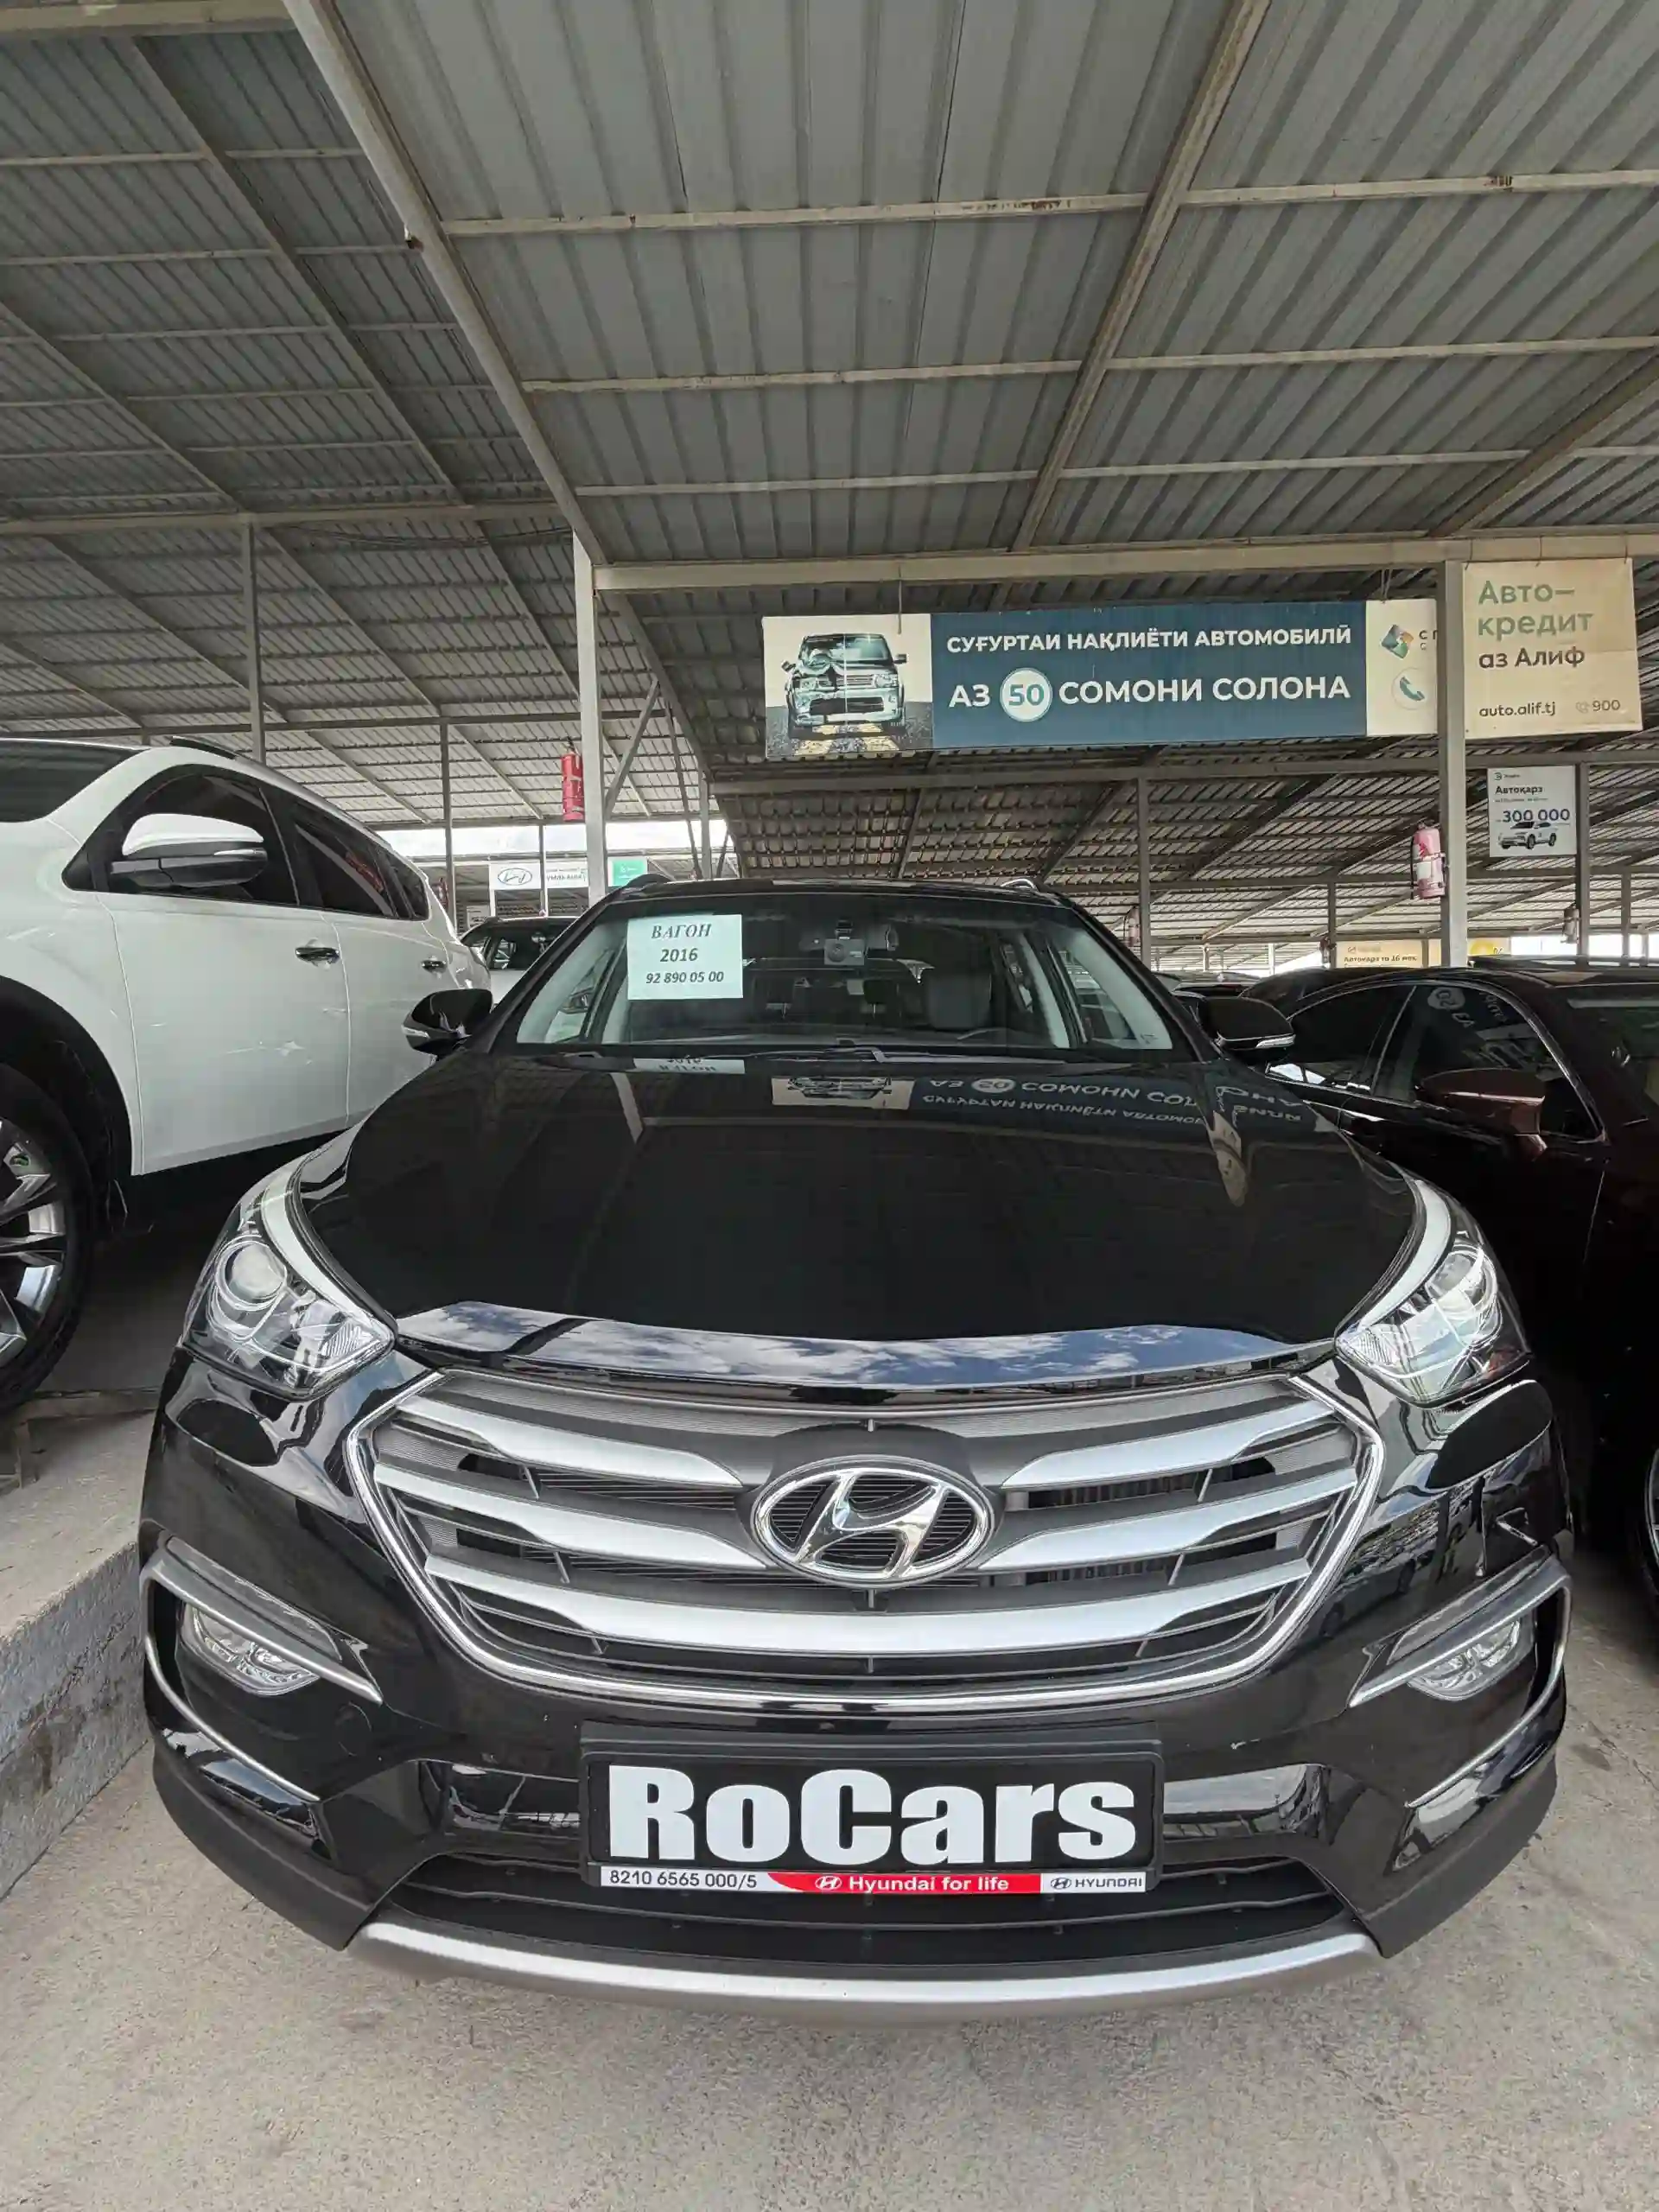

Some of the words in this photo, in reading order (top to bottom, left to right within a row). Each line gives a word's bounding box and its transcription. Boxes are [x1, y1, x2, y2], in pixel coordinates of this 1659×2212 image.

[1478, 613, 1594, 641] кредит
[947, 634, 1061, 654] СУҒУРТАИ
[1067, 627, 1188, 652] НАҚЛИЁТИ
[1478, 652, 1508, 669] аз
[1514, 646, 1586, 668] Алиф
[949, 683, 990, 708] АЗ
[1007, 683, 1046, 707] 50
[1058, 678, 1203, 705] СОМОНИ
[1212, 675, 1351, 702] СОЛОНА
[1478, 701, 1556, 717] auto.alif.tj
[1592, 699, 1621, 712] 900
[1502, 809, 1534, 823] 300
[1537, 808, 1571, 821] 000
[651, 924, 712, 939] ВАГОН
[659, 948, 699, 963] 2016
[645, 973, 661, 983] 92
[664, 972, 687, 983] 890
[690, 971, 705, 983] 05
[709, 971, 724, 982] 00
[607, 1764, 1137, 1866] RoCars
[609, 1869, 652, 1885] 8210
[657, 1871, 700, 1887] 6565
[704, 1872, 758, 1891] 000/5
[849, 1876, 936, 1893] Hyundai
[941, 1876, 972, 1891] for
[977, 1876, 1010, 1891] life
[1074, 1878, 1143, 1888] HYUNDAI
